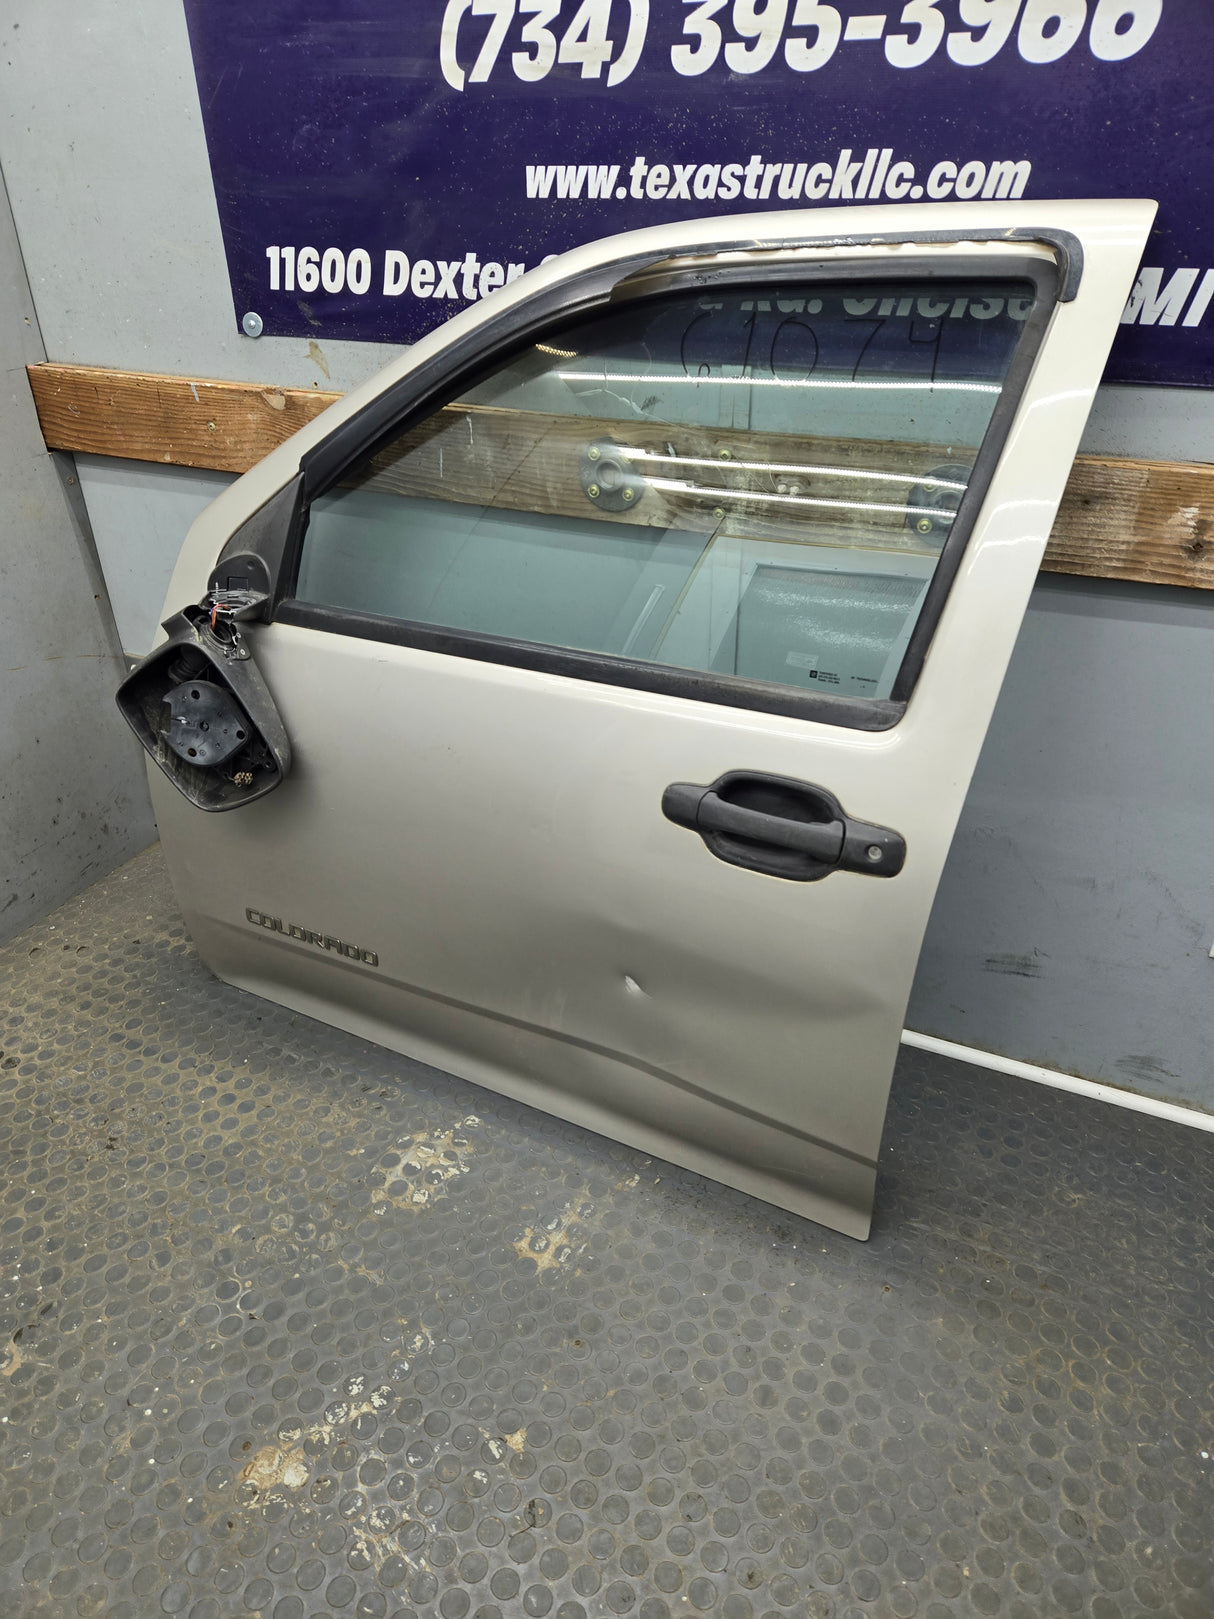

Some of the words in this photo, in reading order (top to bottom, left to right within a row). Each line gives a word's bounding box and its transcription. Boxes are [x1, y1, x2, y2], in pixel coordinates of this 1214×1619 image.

[440, 0, 650, 92] (734)
[525, 148, 1032, 200] www.texastruckllc.com
[265, 246, 371, 294] 11600
[383, 250, 526, 299] Dexter
[246, 907, 379, 967] COLORADO
